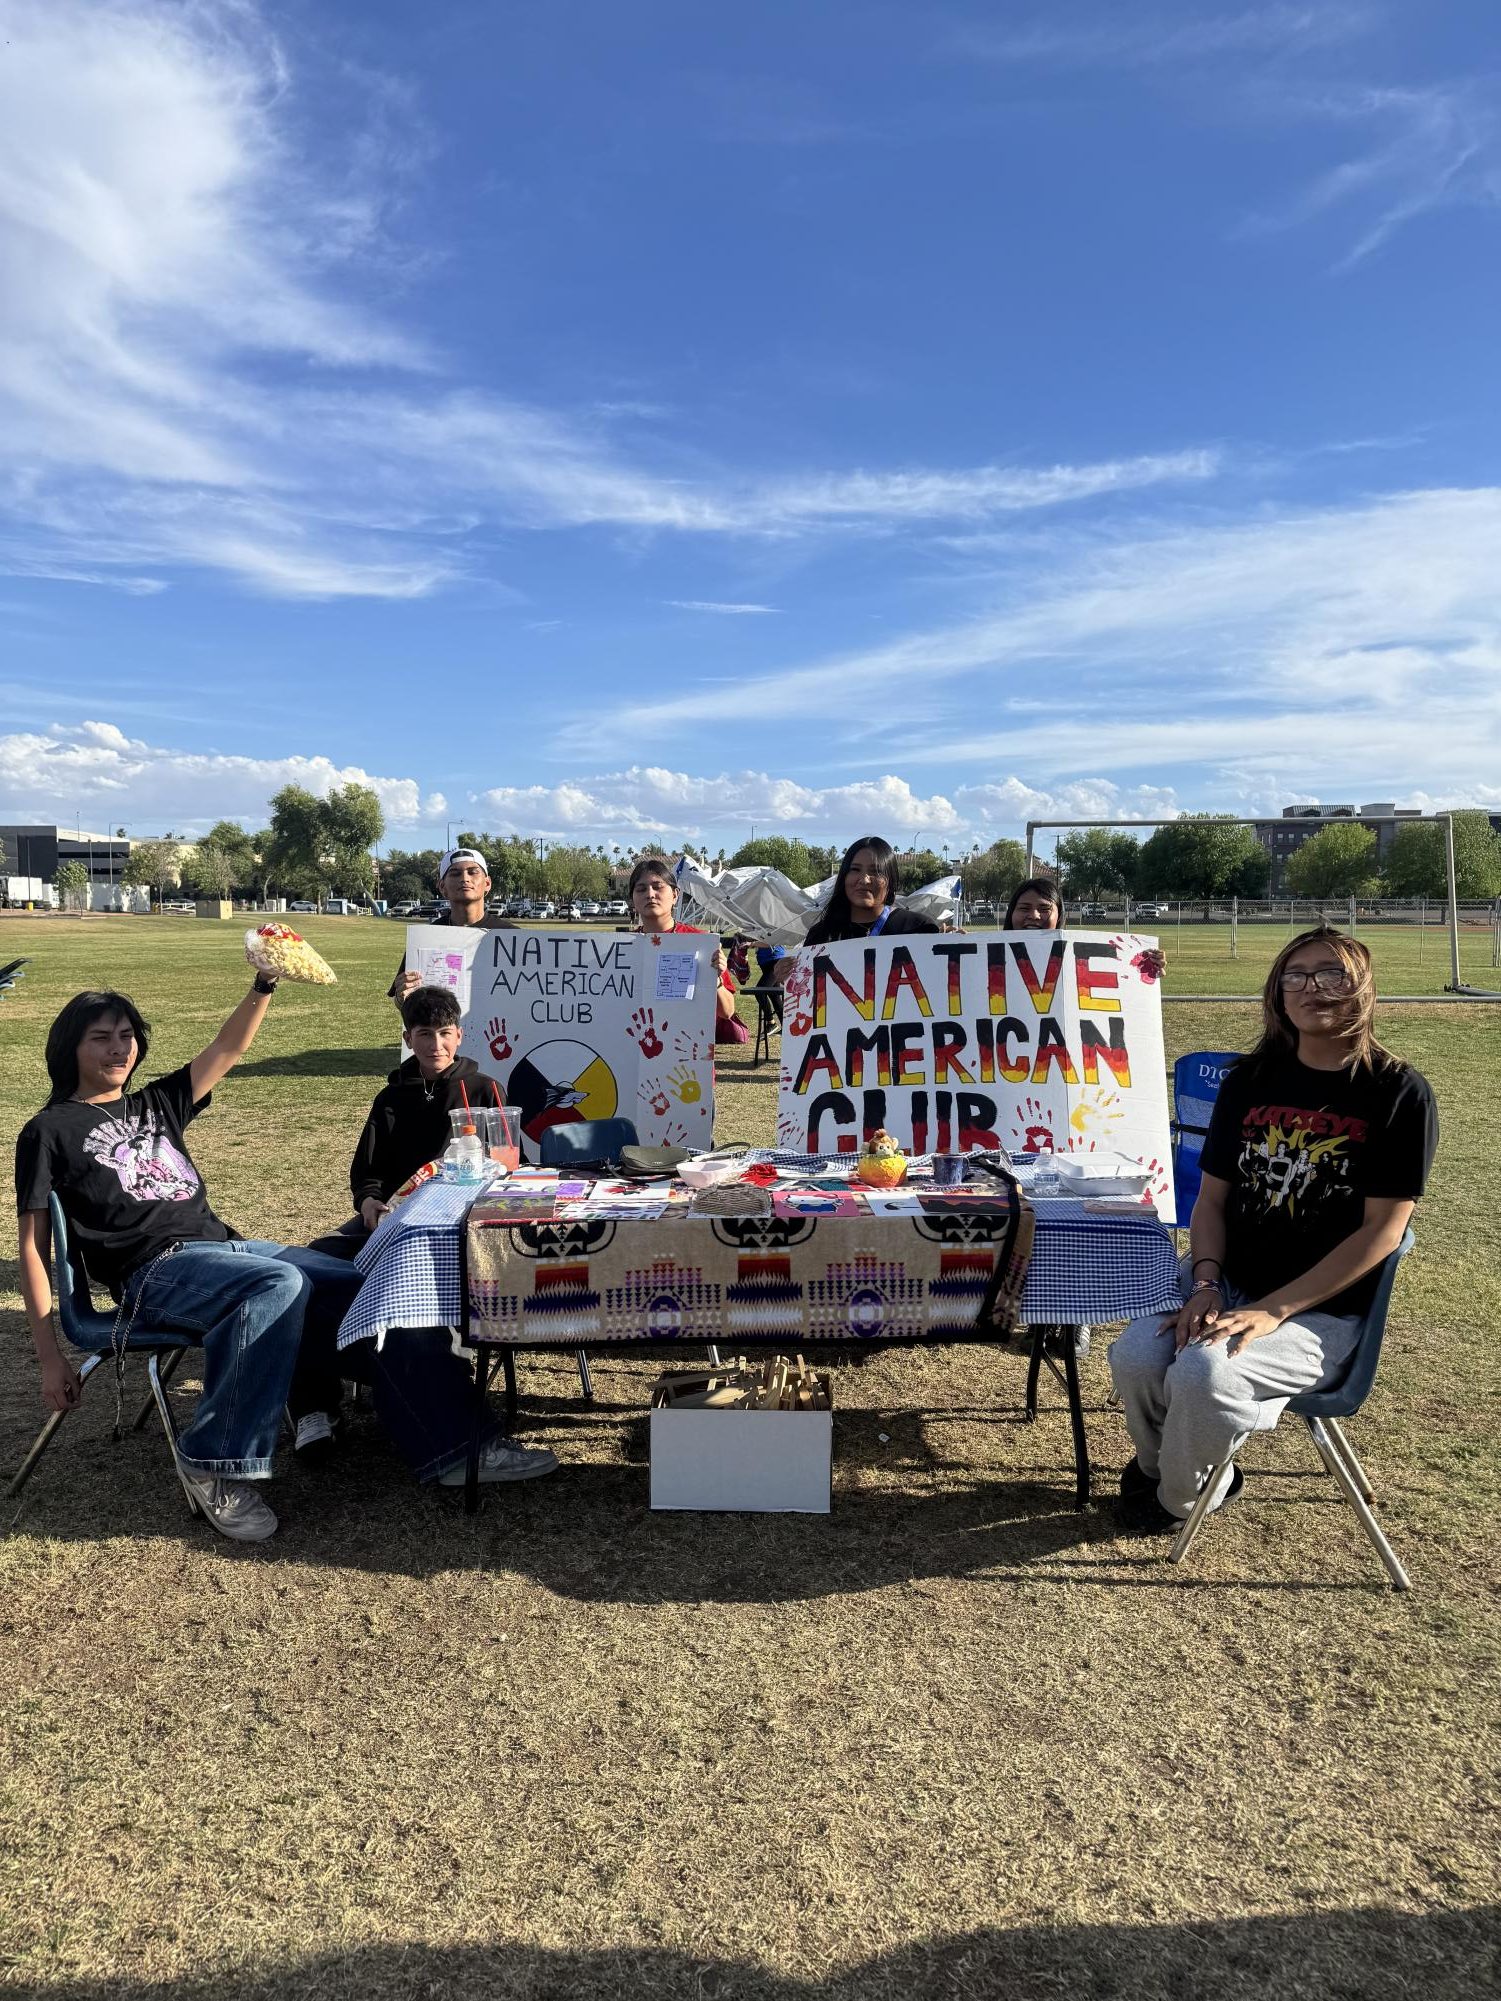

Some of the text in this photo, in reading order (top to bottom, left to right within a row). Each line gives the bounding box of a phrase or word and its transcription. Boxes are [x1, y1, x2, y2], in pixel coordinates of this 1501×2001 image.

[493, 935, 633, 969] NATIVE
[490, 969, 634, 998] AMERICAN
[812, 940, 1122, 1028] NATIVE
[530, 1000, 593, 1024] CLUB
[795, 1016, 1131, 1095] AMERICAN
